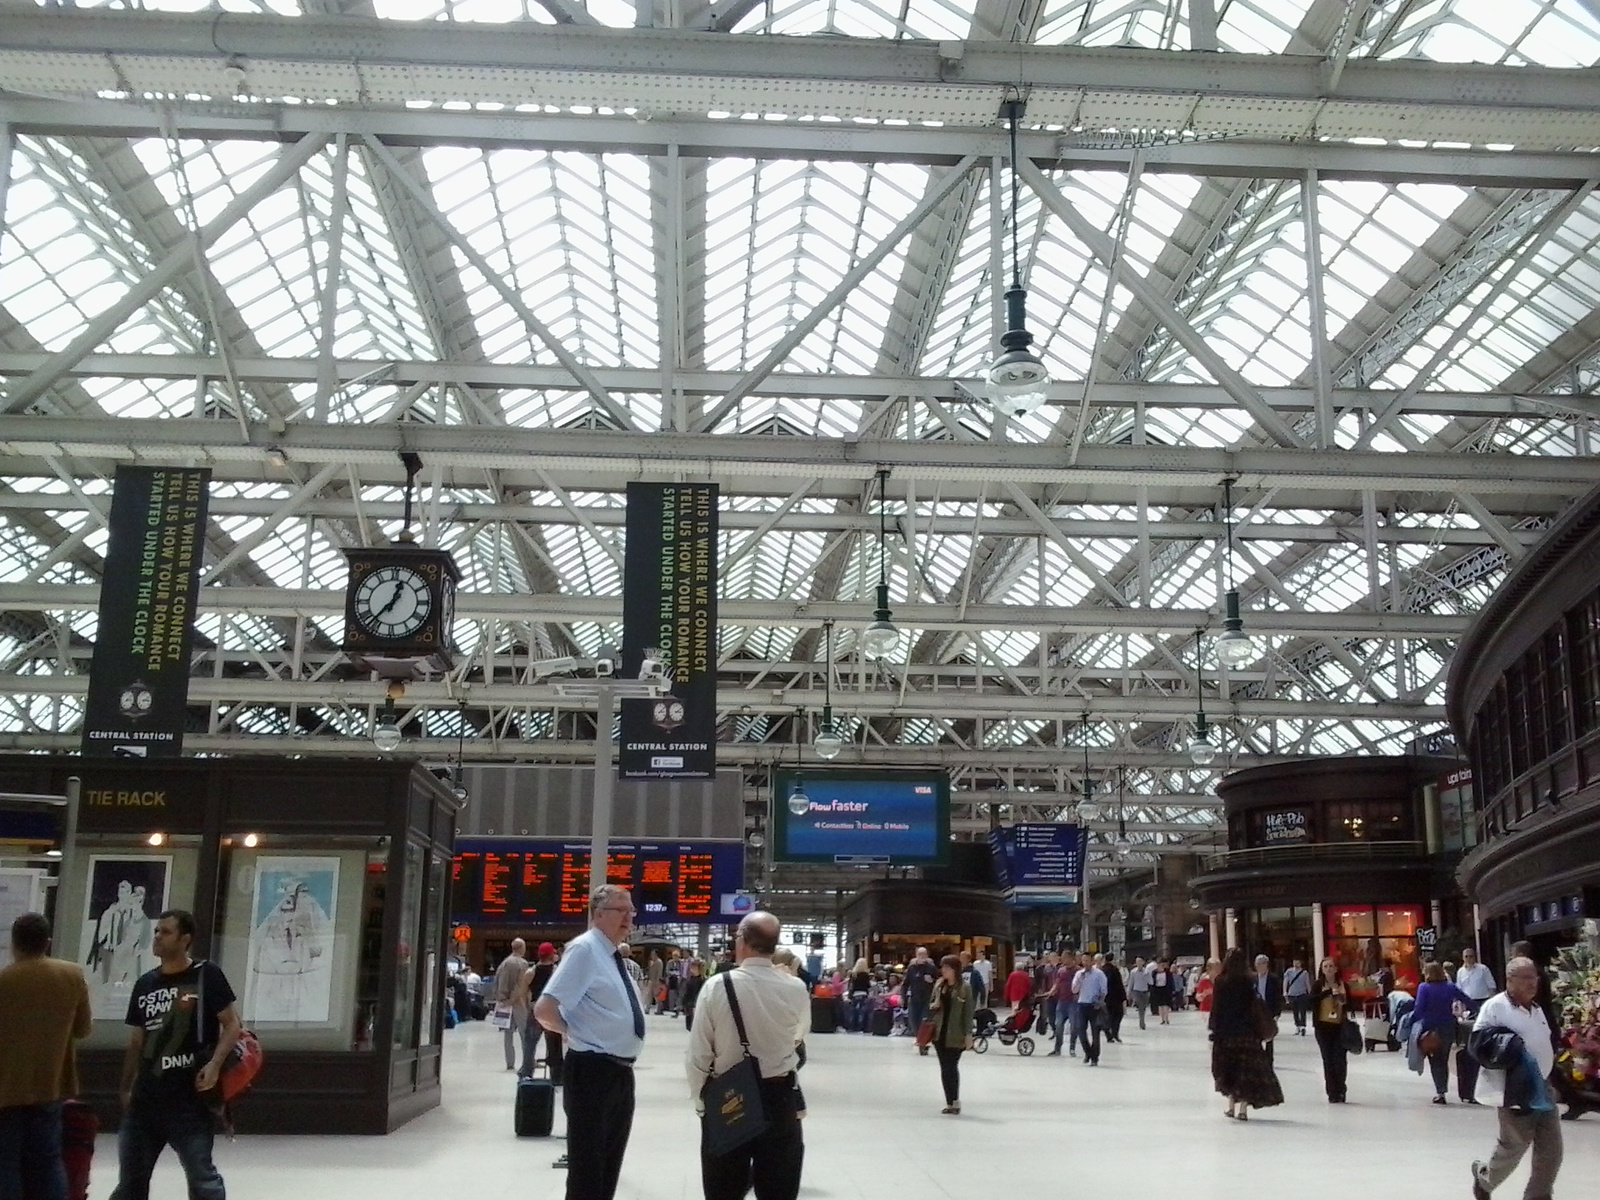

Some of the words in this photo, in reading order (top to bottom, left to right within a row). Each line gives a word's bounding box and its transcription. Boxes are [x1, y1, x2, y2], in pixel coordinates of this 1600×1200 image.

[147, 471, 165, 526] STARTED
[168, 473, 183, 500] TELL
[186, 473, 201, 501] THIS
[166, 504, 179, 521] US
[184, 507, 197, 518] IS
[662, 487, 675, 541] STARTED
[680, 488, 692, 515] TELL
[697, 488, 709, 517] THIS
[680, 520, 692, 536] US
[697, 521, 709, 533] IS
[141, 531, 158, 575] UNDER
[161, 526, 177, 558] HOW
[179, 523, 195, 567] WHERE
[661, 546, 674, 590] UNDER
[679, 541, 691, 573] HOW
[696, 537, 708, 581] WHERE
[138, 580, 152, 605] THE
[156, 562, 173, 599] YOUR
[176, 572, 190, 591] WE
[678, 576, 690, 612] YOUR
[695, 586, 707, 604] WE
[660, 595, 673, 619] THE
[131, 610, 148, 654] CLOCK
[148, 604, 168, 670] ROMANCE
[167, 596, 186, 660] CONNECT
[694, 609, 707, 672] CONNECT
[660, 624, 673, 666] CLOCK
[677, 617, 690, 682] ROMANCE
[89, 731, 130, 739] CENTRAL
[133, 732, 174, 740] STATION
[669, 743, 707, 751] STATION
[87, 790, 113, 805] TIE
[117, 791, 166, 806] RACK
[914, 786, 932, 794] VISA
[146, 1000, 172, 1018] RAW
